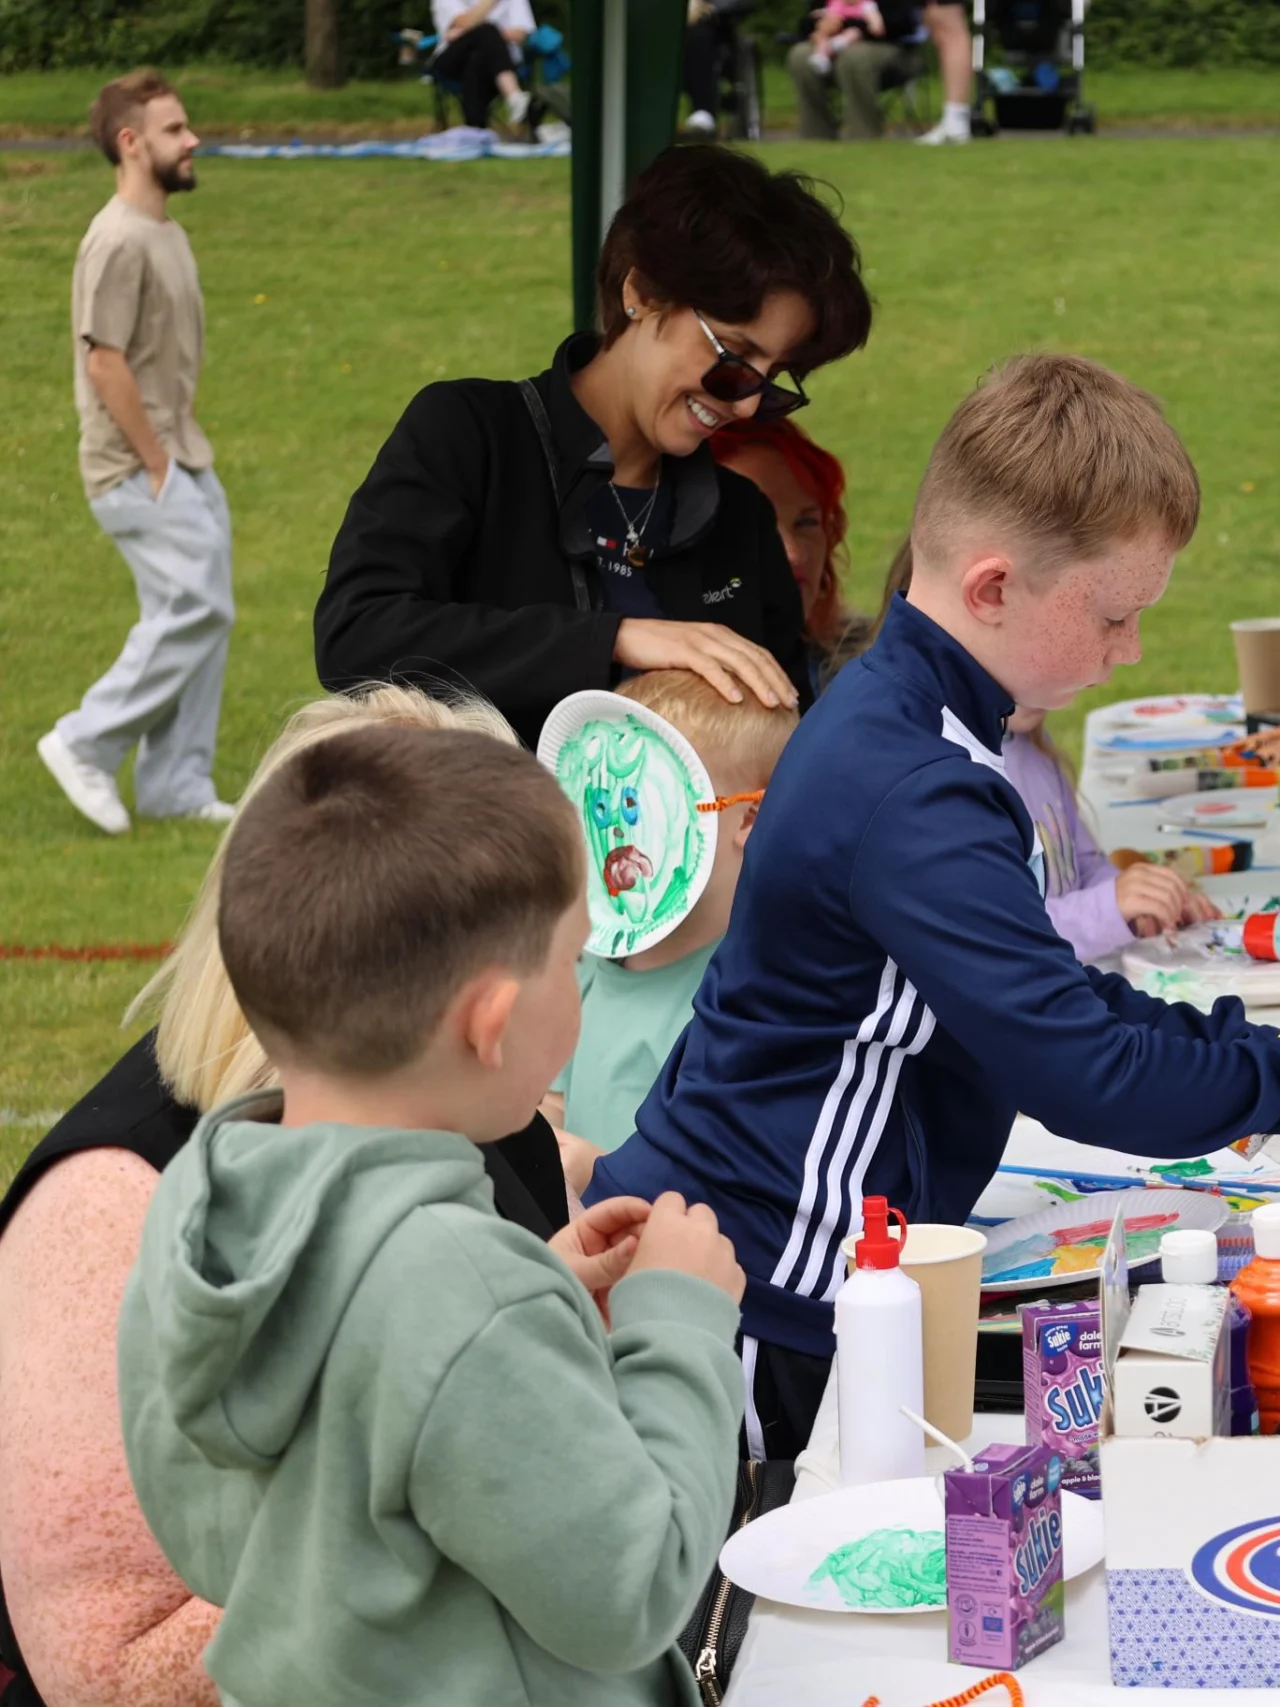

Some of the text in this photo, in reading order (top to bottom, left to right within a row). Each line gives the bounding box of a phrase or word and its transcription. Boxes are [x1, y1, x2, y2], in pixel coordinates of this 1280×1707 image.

[608, 560, 633, 577] 1985
[1047, 1330, 1071, 1348] Sukie
[1061, 1475, 1081, 1485] apple
[1015, 1507, 1063, 1596] Sukie
